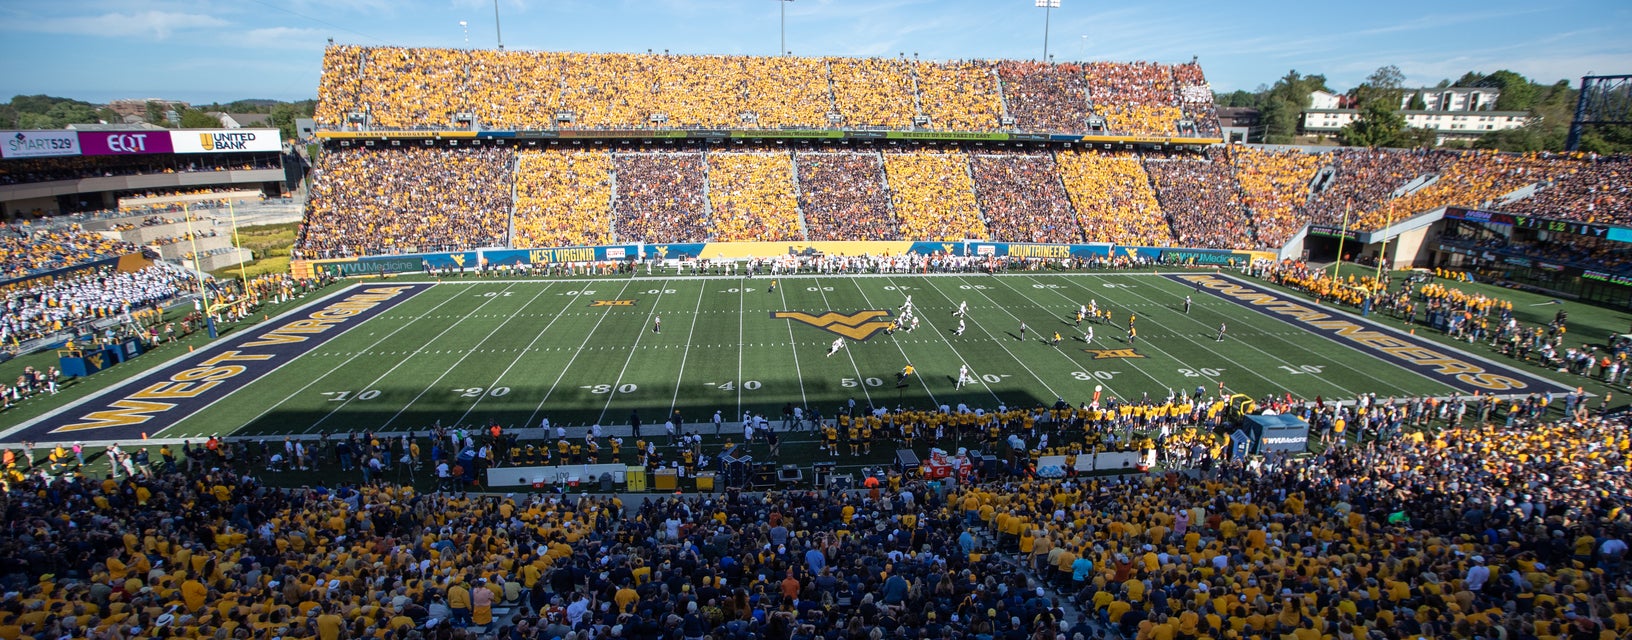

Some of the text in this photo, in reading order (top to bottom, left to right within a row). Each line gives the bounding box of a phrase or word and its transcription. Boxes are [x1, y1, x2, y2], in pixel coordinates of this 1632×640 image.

[107, 134, 147, 152] EQT
[214, 133, 256, 141] UNITED
[215, 141, 247, 149] BANK
[530, 249, 553, 263] WEST
[555, 248, 595, 262] VIRGINIA
[1008, 244, 1071, 258] MOUNTAINEERS
[340, 261, 412, 273] WVUMedicine
[1183, 274, 1529, 391] MOUNTAINEERS
[46, 284, 415, 433] WEST VIRGINIA
[1070, 370, 1114, 380] 30
[1177, 367, 1221, 377] 20
[590, 383, 638, 394] 30
[718, 380, 762, 391] 40
[841, 377, 884, 388] 50
[327, 389, 382, 401] 10
[459, 386, 511, 398] 20
